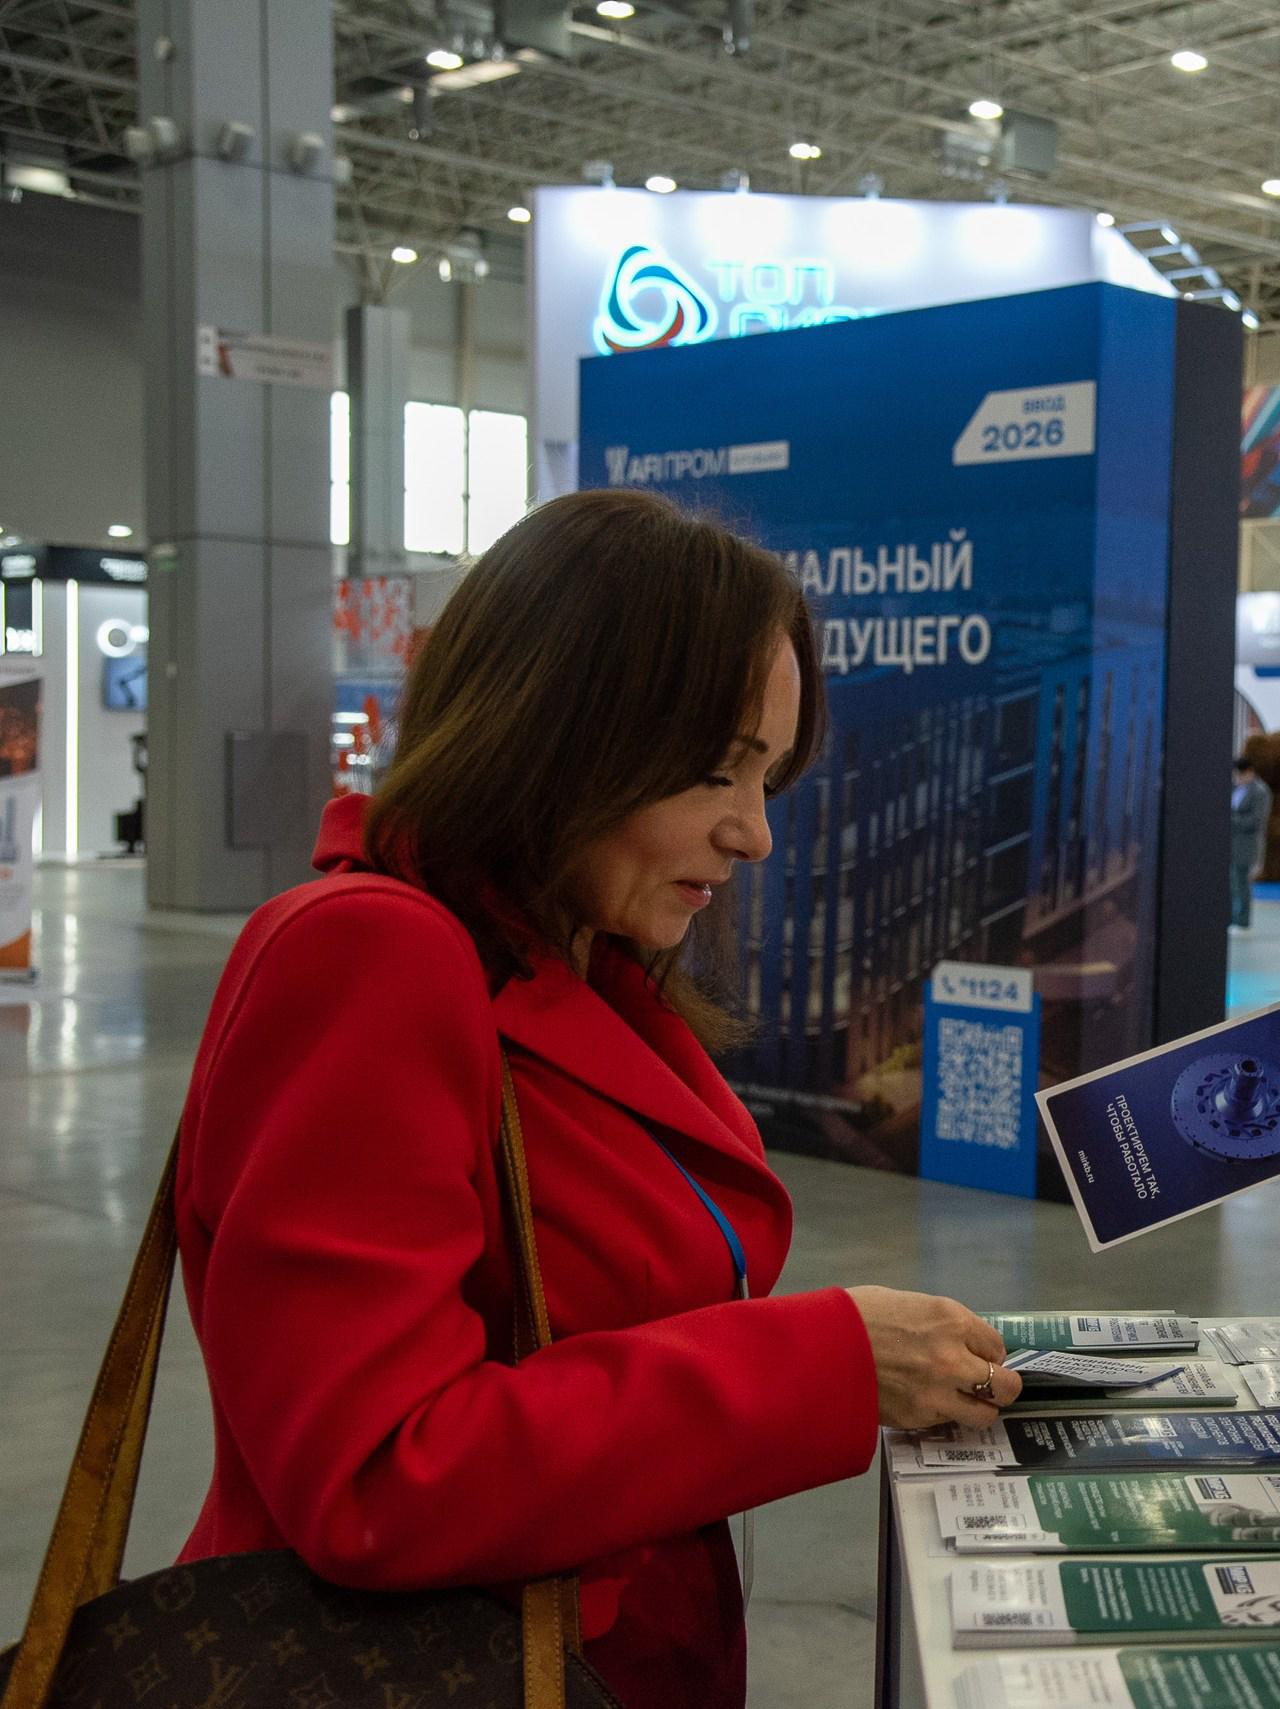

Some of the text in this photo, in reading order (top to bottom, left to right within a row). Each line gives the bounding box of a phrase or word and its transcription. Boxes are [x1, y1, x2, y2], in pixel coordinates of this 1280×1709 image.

[704, 257, 835, 306] ТОП
[982, 418, 1065, 452] 2026
[820, 614, 992, 675] ДУЩЕГО
[1106, 1103, 1148, 1199] ЧТОБЫ РАБОТАЛО
[1115, 1094, 1161, 1199] ПРОЕКТИРУЕМ ТАК,
[1078, 1150, 1095, 1184] mirkb.ru
[1049, 1353, 1146, 1370] ИНЖИНИРИНГ
[1072, 1361, 1144, 1375] КОСМОСА
[1264, 1476, 1280, 1488] ДЛЯ
